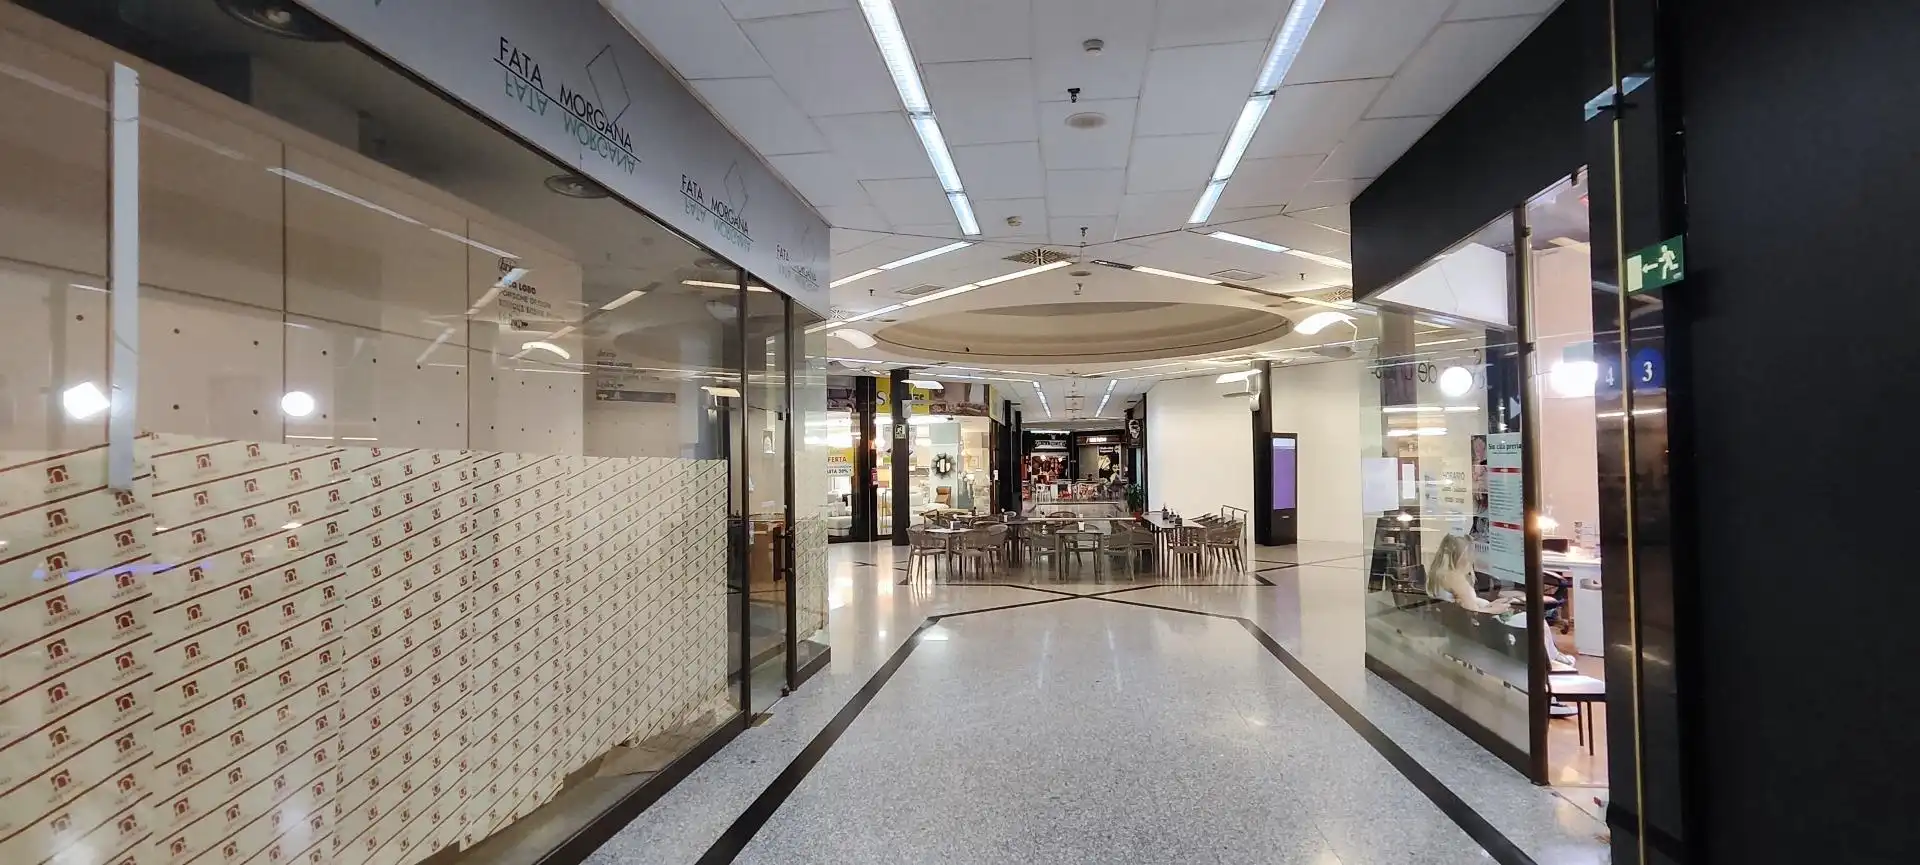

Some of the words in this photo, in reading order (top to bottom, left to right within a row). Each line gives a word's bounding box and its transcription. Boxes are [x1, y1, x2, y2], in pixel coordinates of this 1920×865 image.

[499, 36, 544, 90] FATA
[560, 84, 633, 153] MORGANA
[681, 173, 704, 203] FATA
[710, 195, 749, 235] MORGANA
[1605, 365, 1615, 386] 4
[1642, 361, 1653, 383] 3
